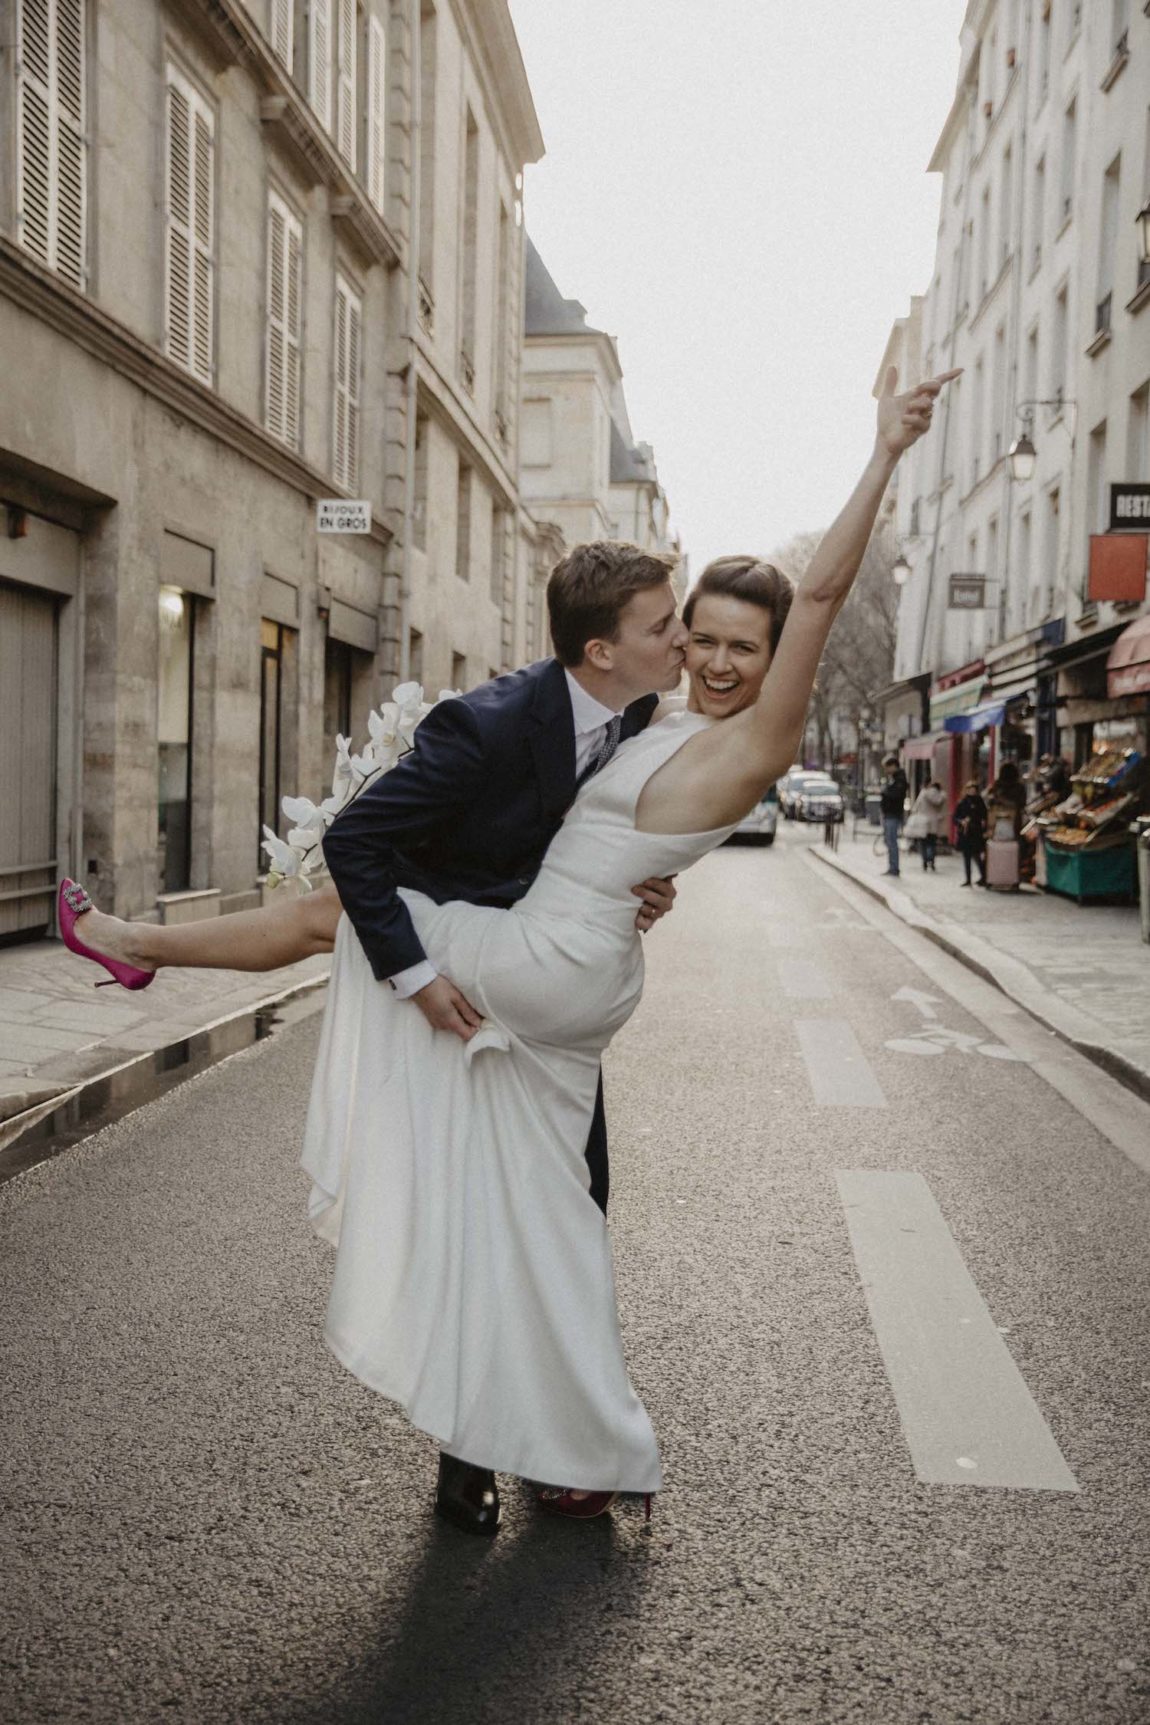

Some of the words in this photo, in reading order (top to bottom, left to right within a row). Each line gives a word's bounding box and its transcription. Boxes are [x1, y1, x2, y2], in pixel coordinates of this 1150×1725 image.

[323, 505, 363, 514] BIJOUX
[1116, 494, 1150, 517] REST
[320, 517, 333, 528] EN
[337, 517, 367, 529] GROS
